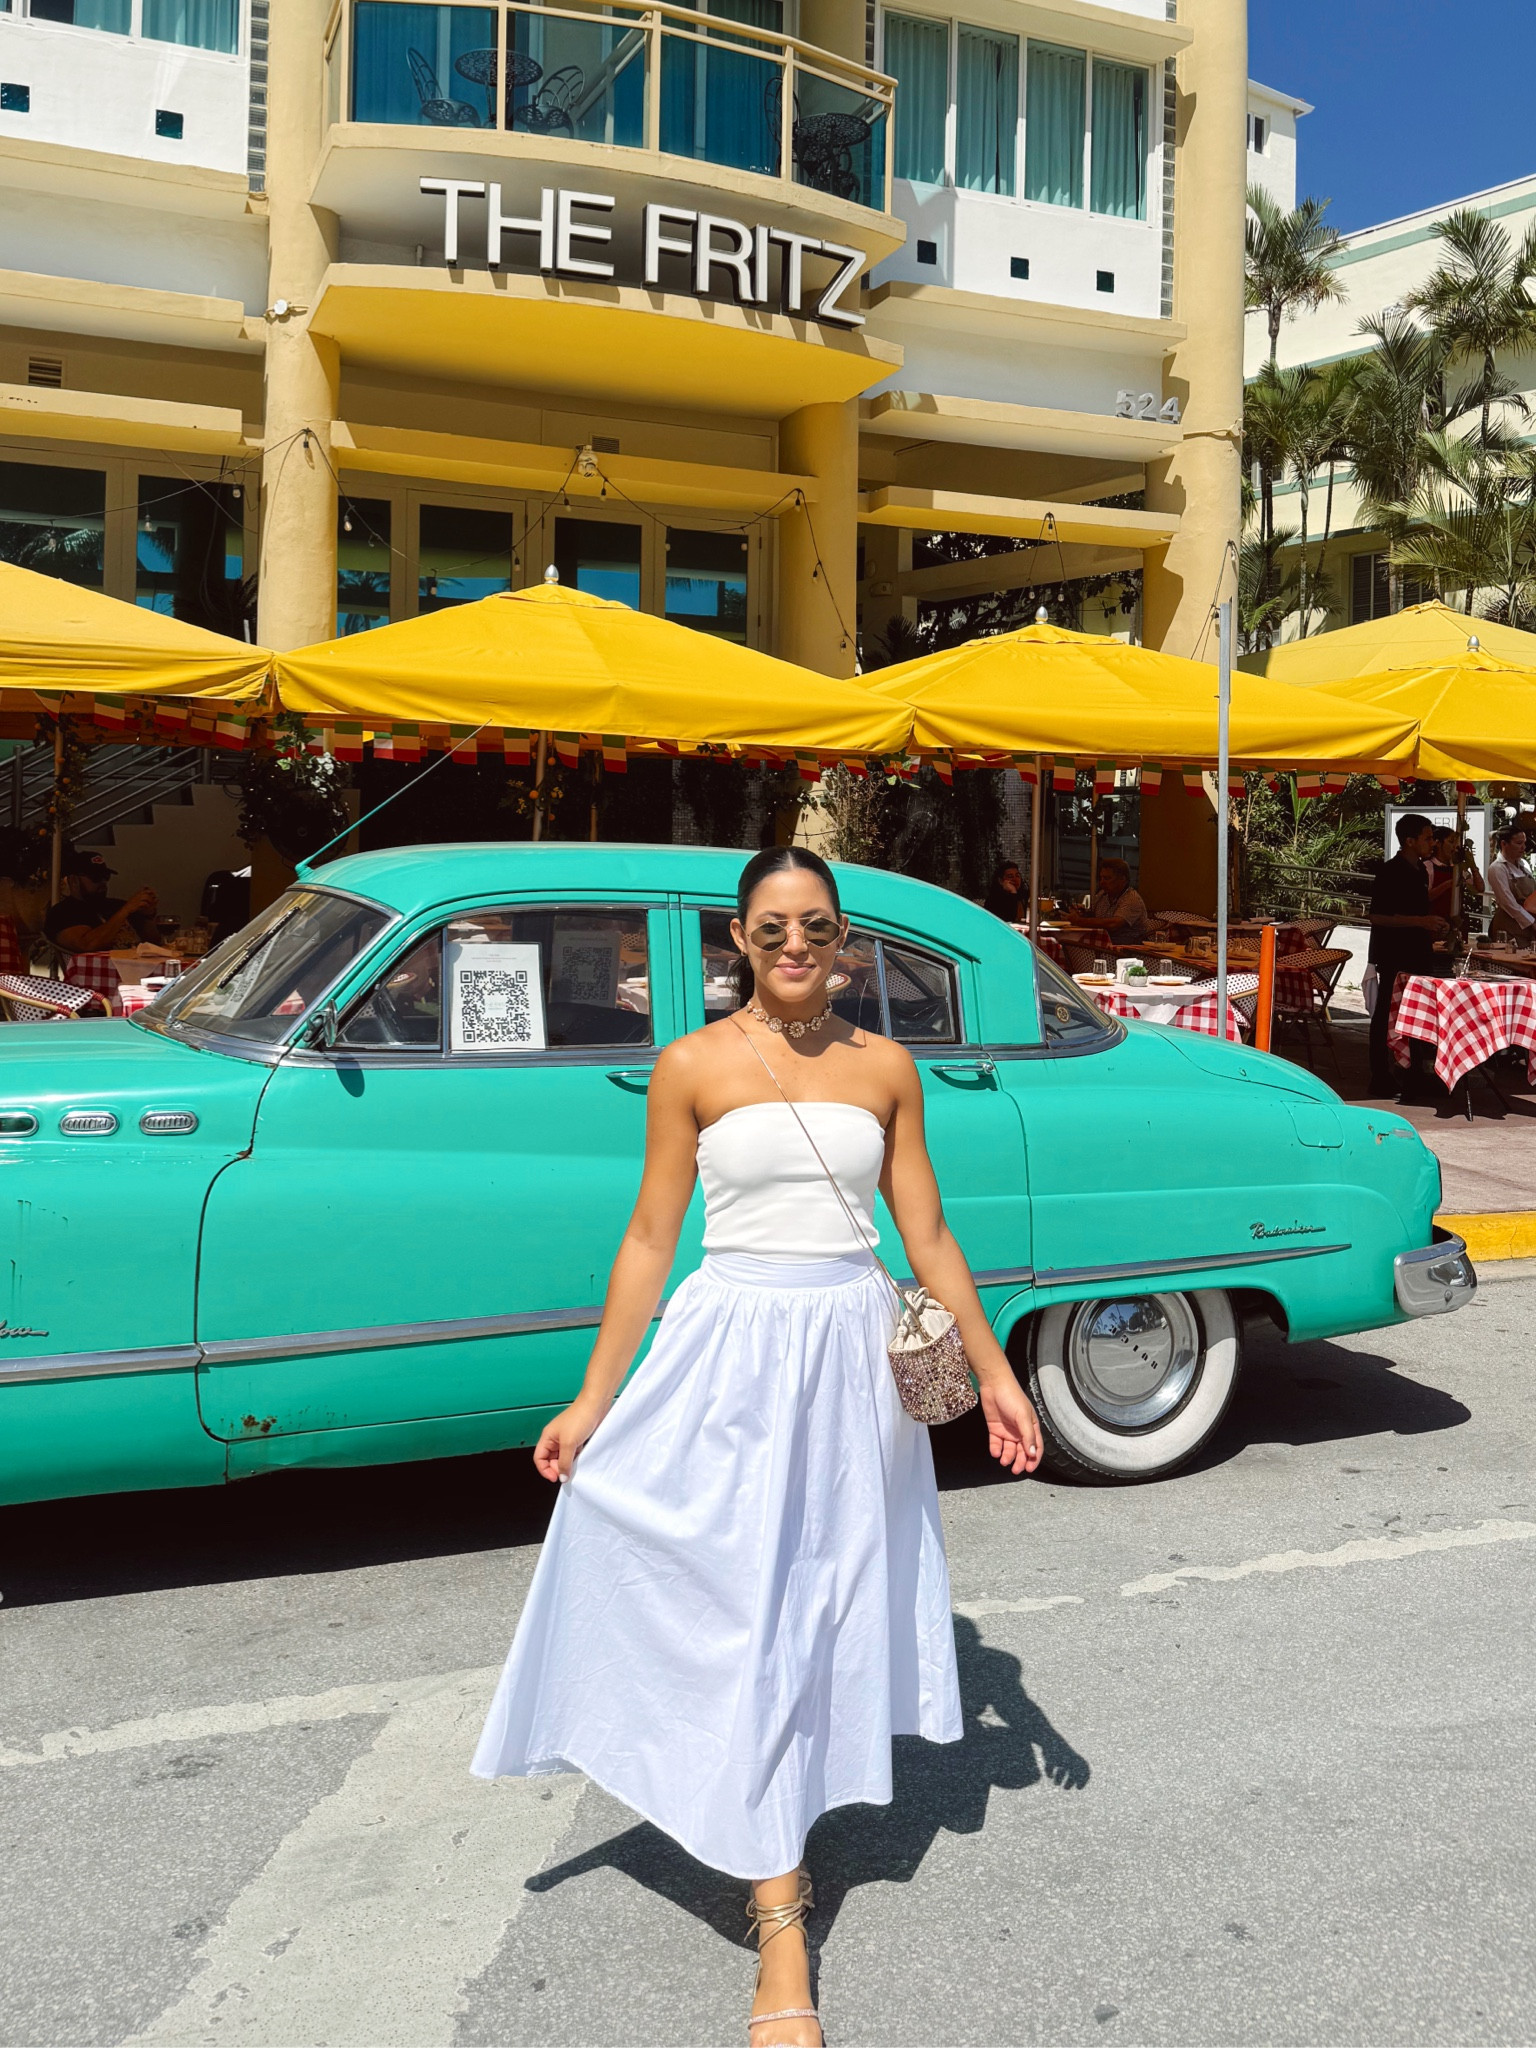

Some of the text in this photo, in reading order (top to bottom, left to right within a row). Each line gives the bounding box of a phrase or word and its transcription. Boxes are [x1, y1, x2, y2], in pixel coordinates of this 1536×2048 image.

[420, 176, 867, 327] THE FRITZ
[1116, 389, 1181, 424] 524
